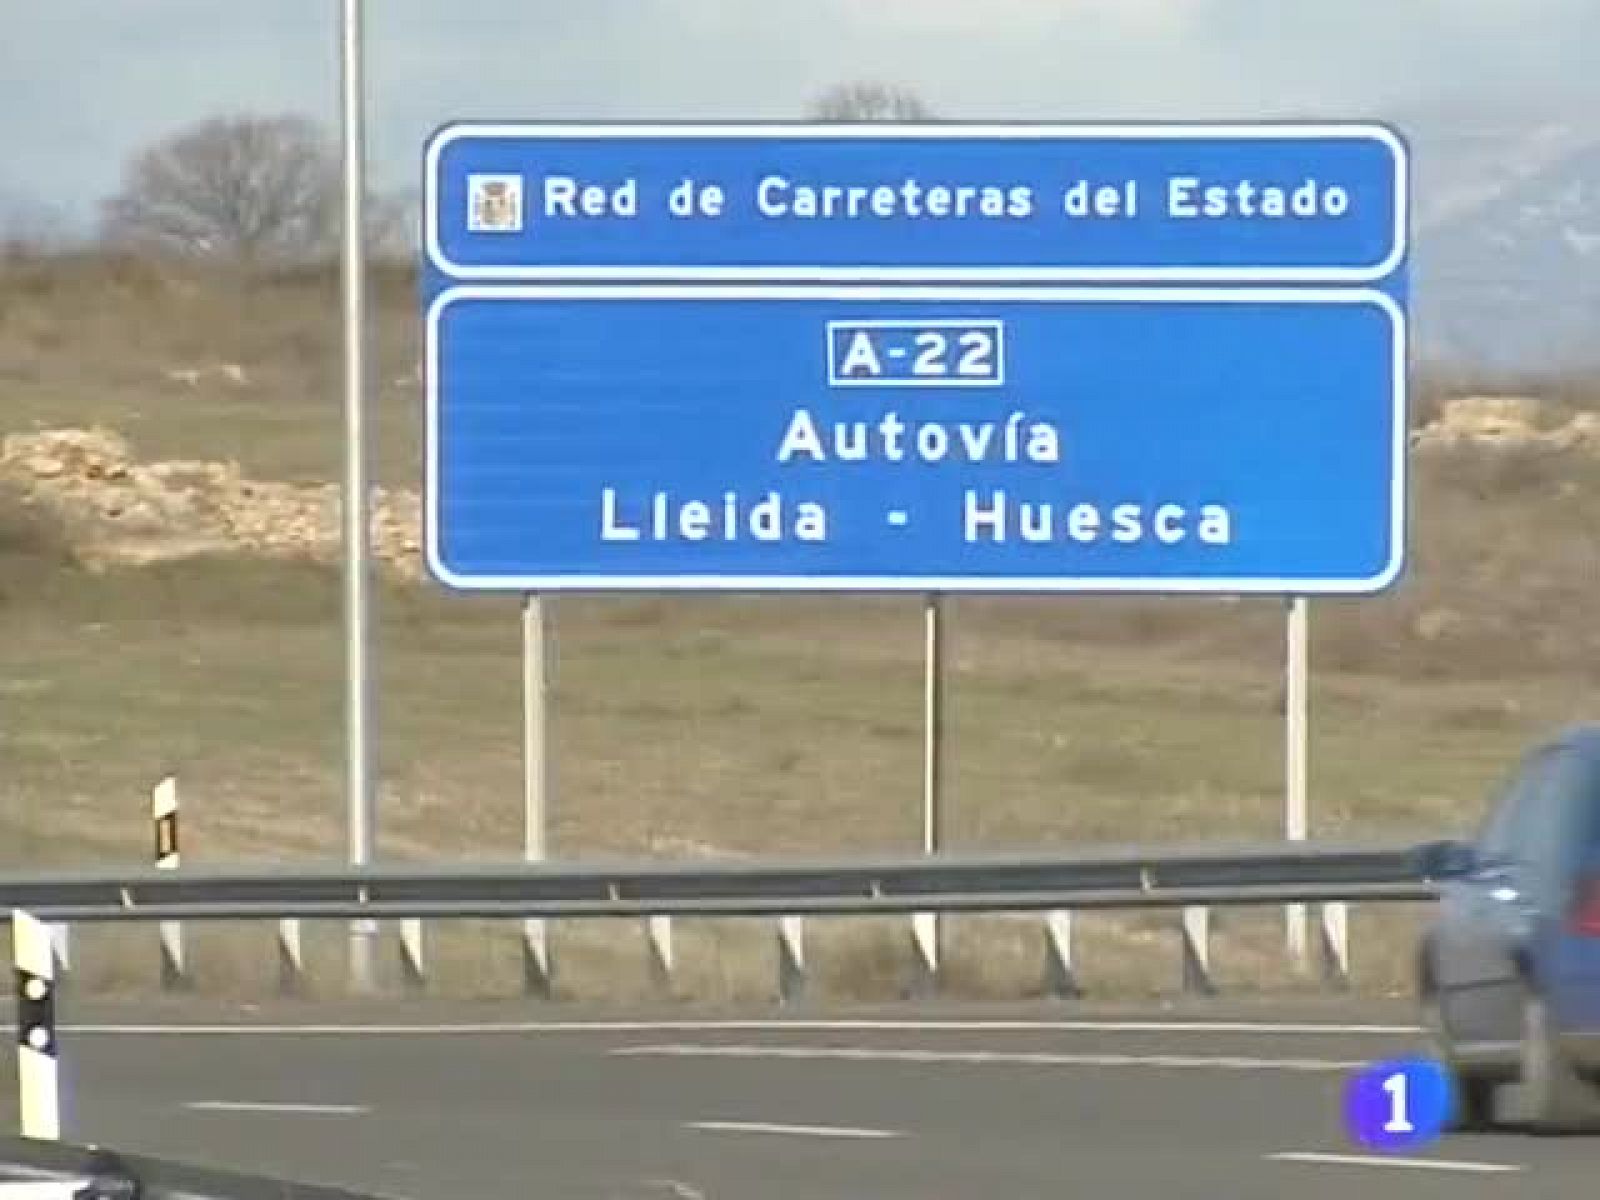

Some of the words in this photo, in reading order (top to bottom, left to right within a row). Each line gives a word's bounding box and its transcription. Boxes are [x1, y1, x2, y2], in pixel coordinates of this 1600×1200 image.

[544, 177, 636, 216] Red
[669, 179, 724, 216] de
[757, 177, 1032, 217] Carreteras
[1064, 179, 1137, 217] del
[1168, 177, 1349, 217] Estado
[841, 332, 993, 376] A-22
[779, 410, 1060, 462] Autovía
[602, 489, 827, 542] Lleida
[888, 511, 907, 525] -
[964, 491, 1231, 544] Huesca
